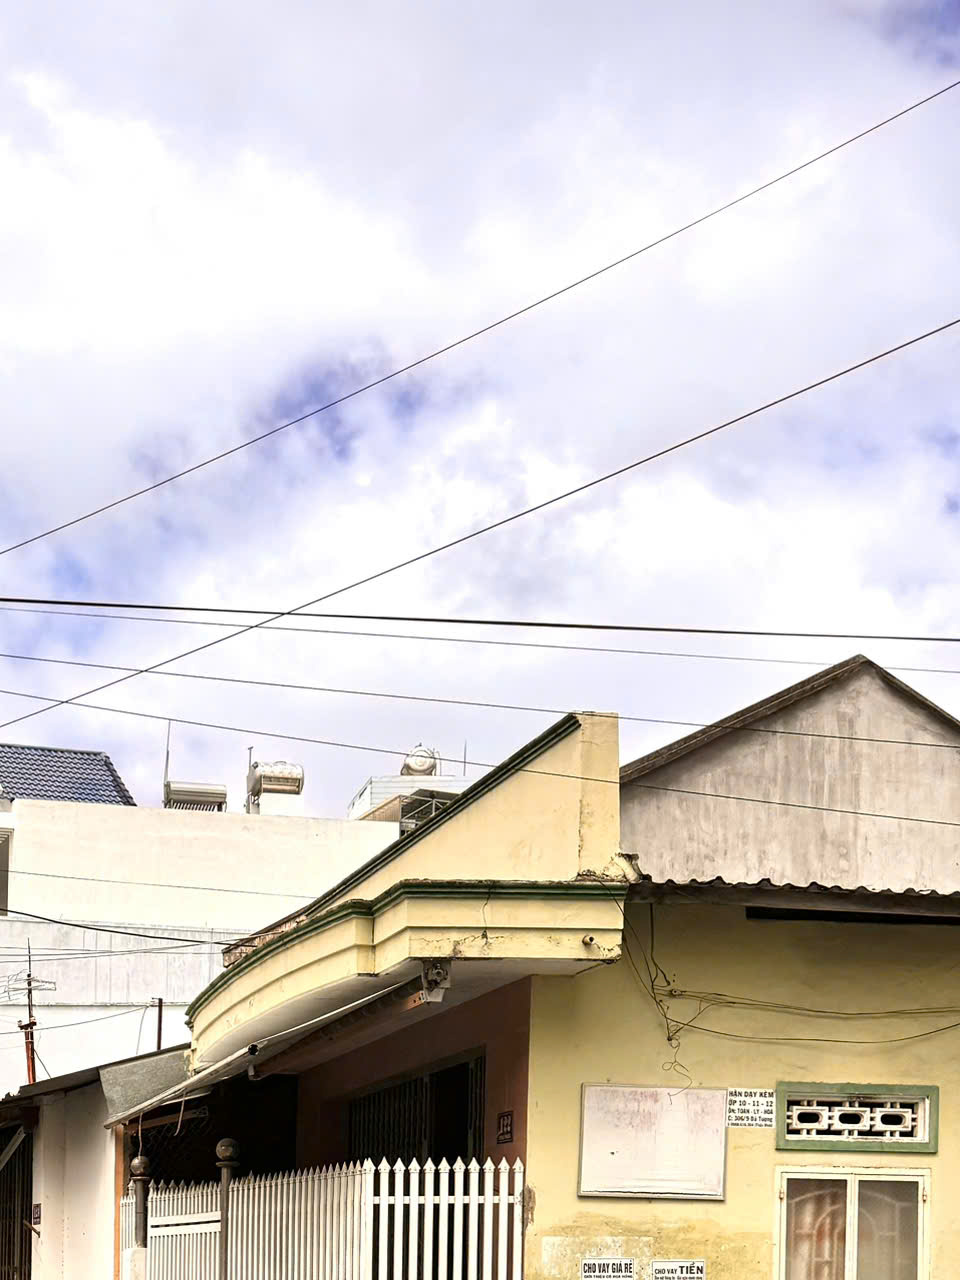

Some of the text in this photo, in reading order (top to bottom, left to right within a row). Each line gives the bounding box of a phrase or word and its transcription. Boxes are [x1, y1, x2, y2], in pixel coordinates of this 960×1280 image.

[583, 1263, 596, 1273] CHO
[598, 1263, 610, 1273] VAY
[611, 1260, 623, 1273] GIÁ
[679, 1261, 703, 1274] TIỀN
